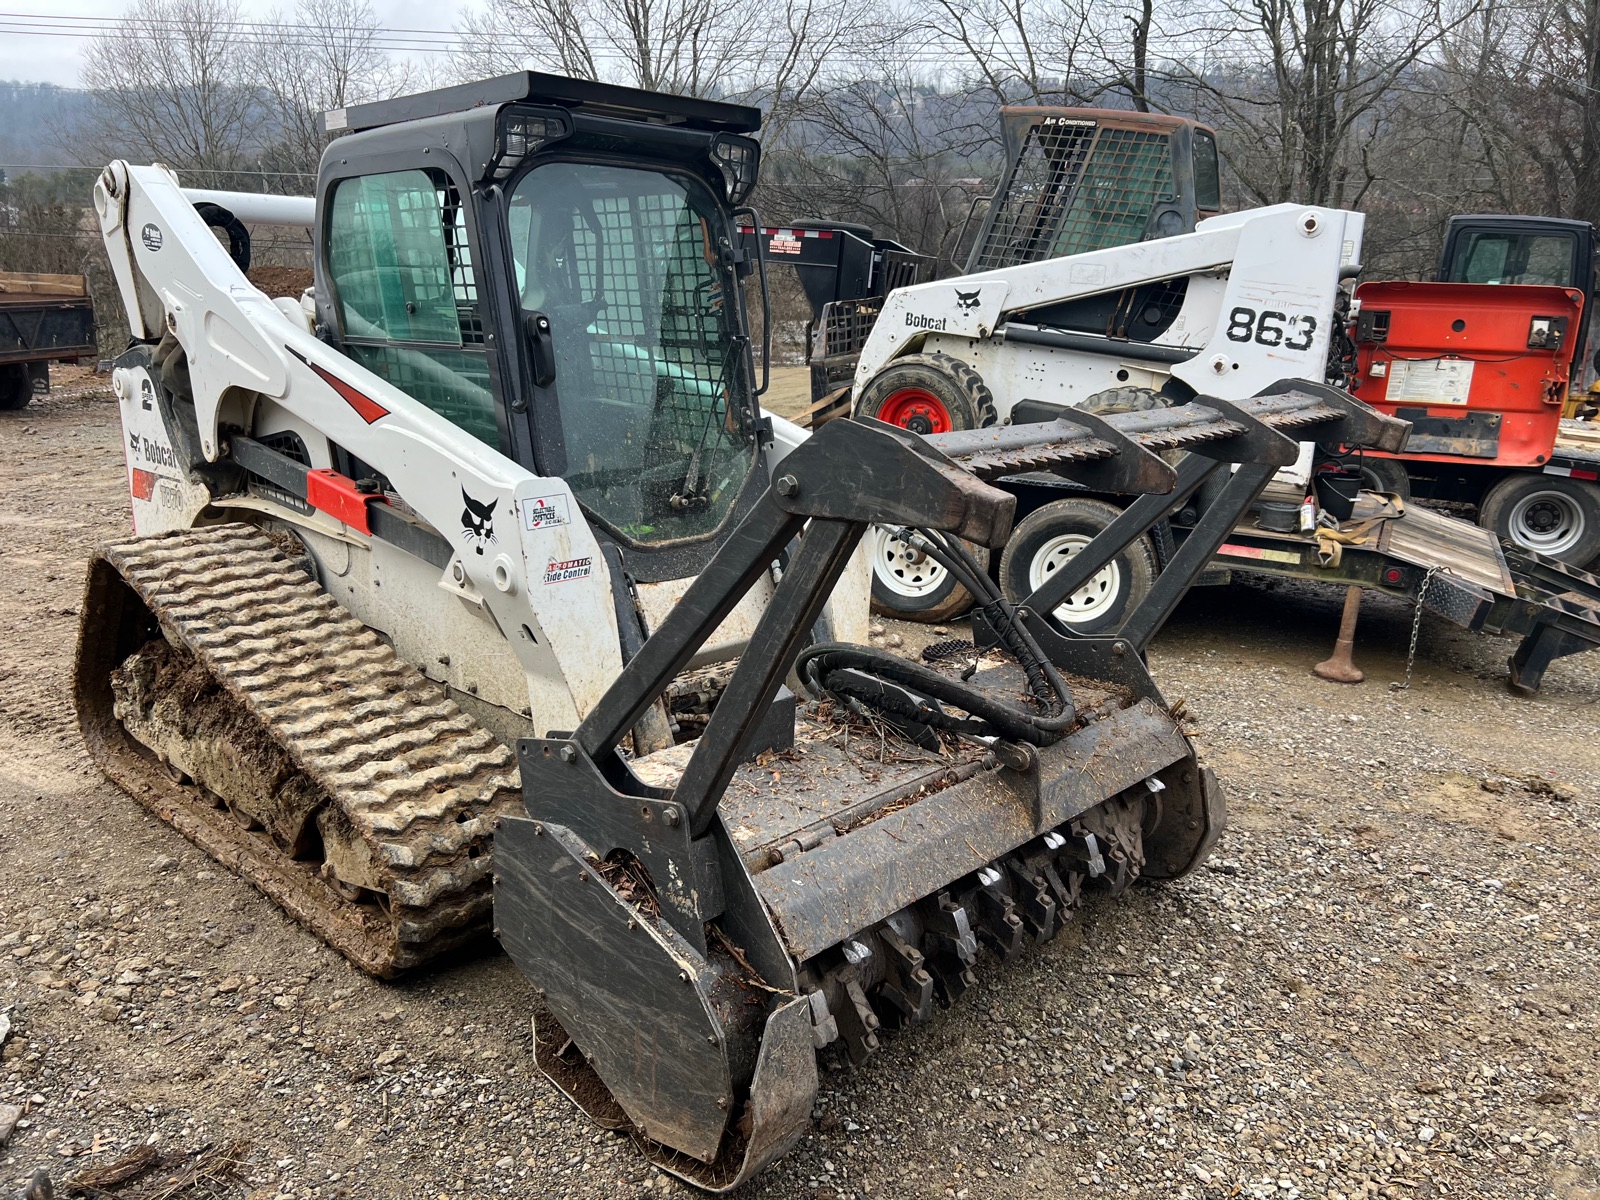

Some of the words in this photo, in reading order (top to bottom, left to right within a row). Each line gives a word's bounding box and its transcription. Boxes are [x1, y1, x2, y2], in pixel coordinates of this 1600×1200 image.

[905, 312, 947, 331] Bobcat
[1226, 306, 1318, 352] 863
[547, 558, 592, 573] AUTOMATIC
[563, 565, 591, 580] Control
